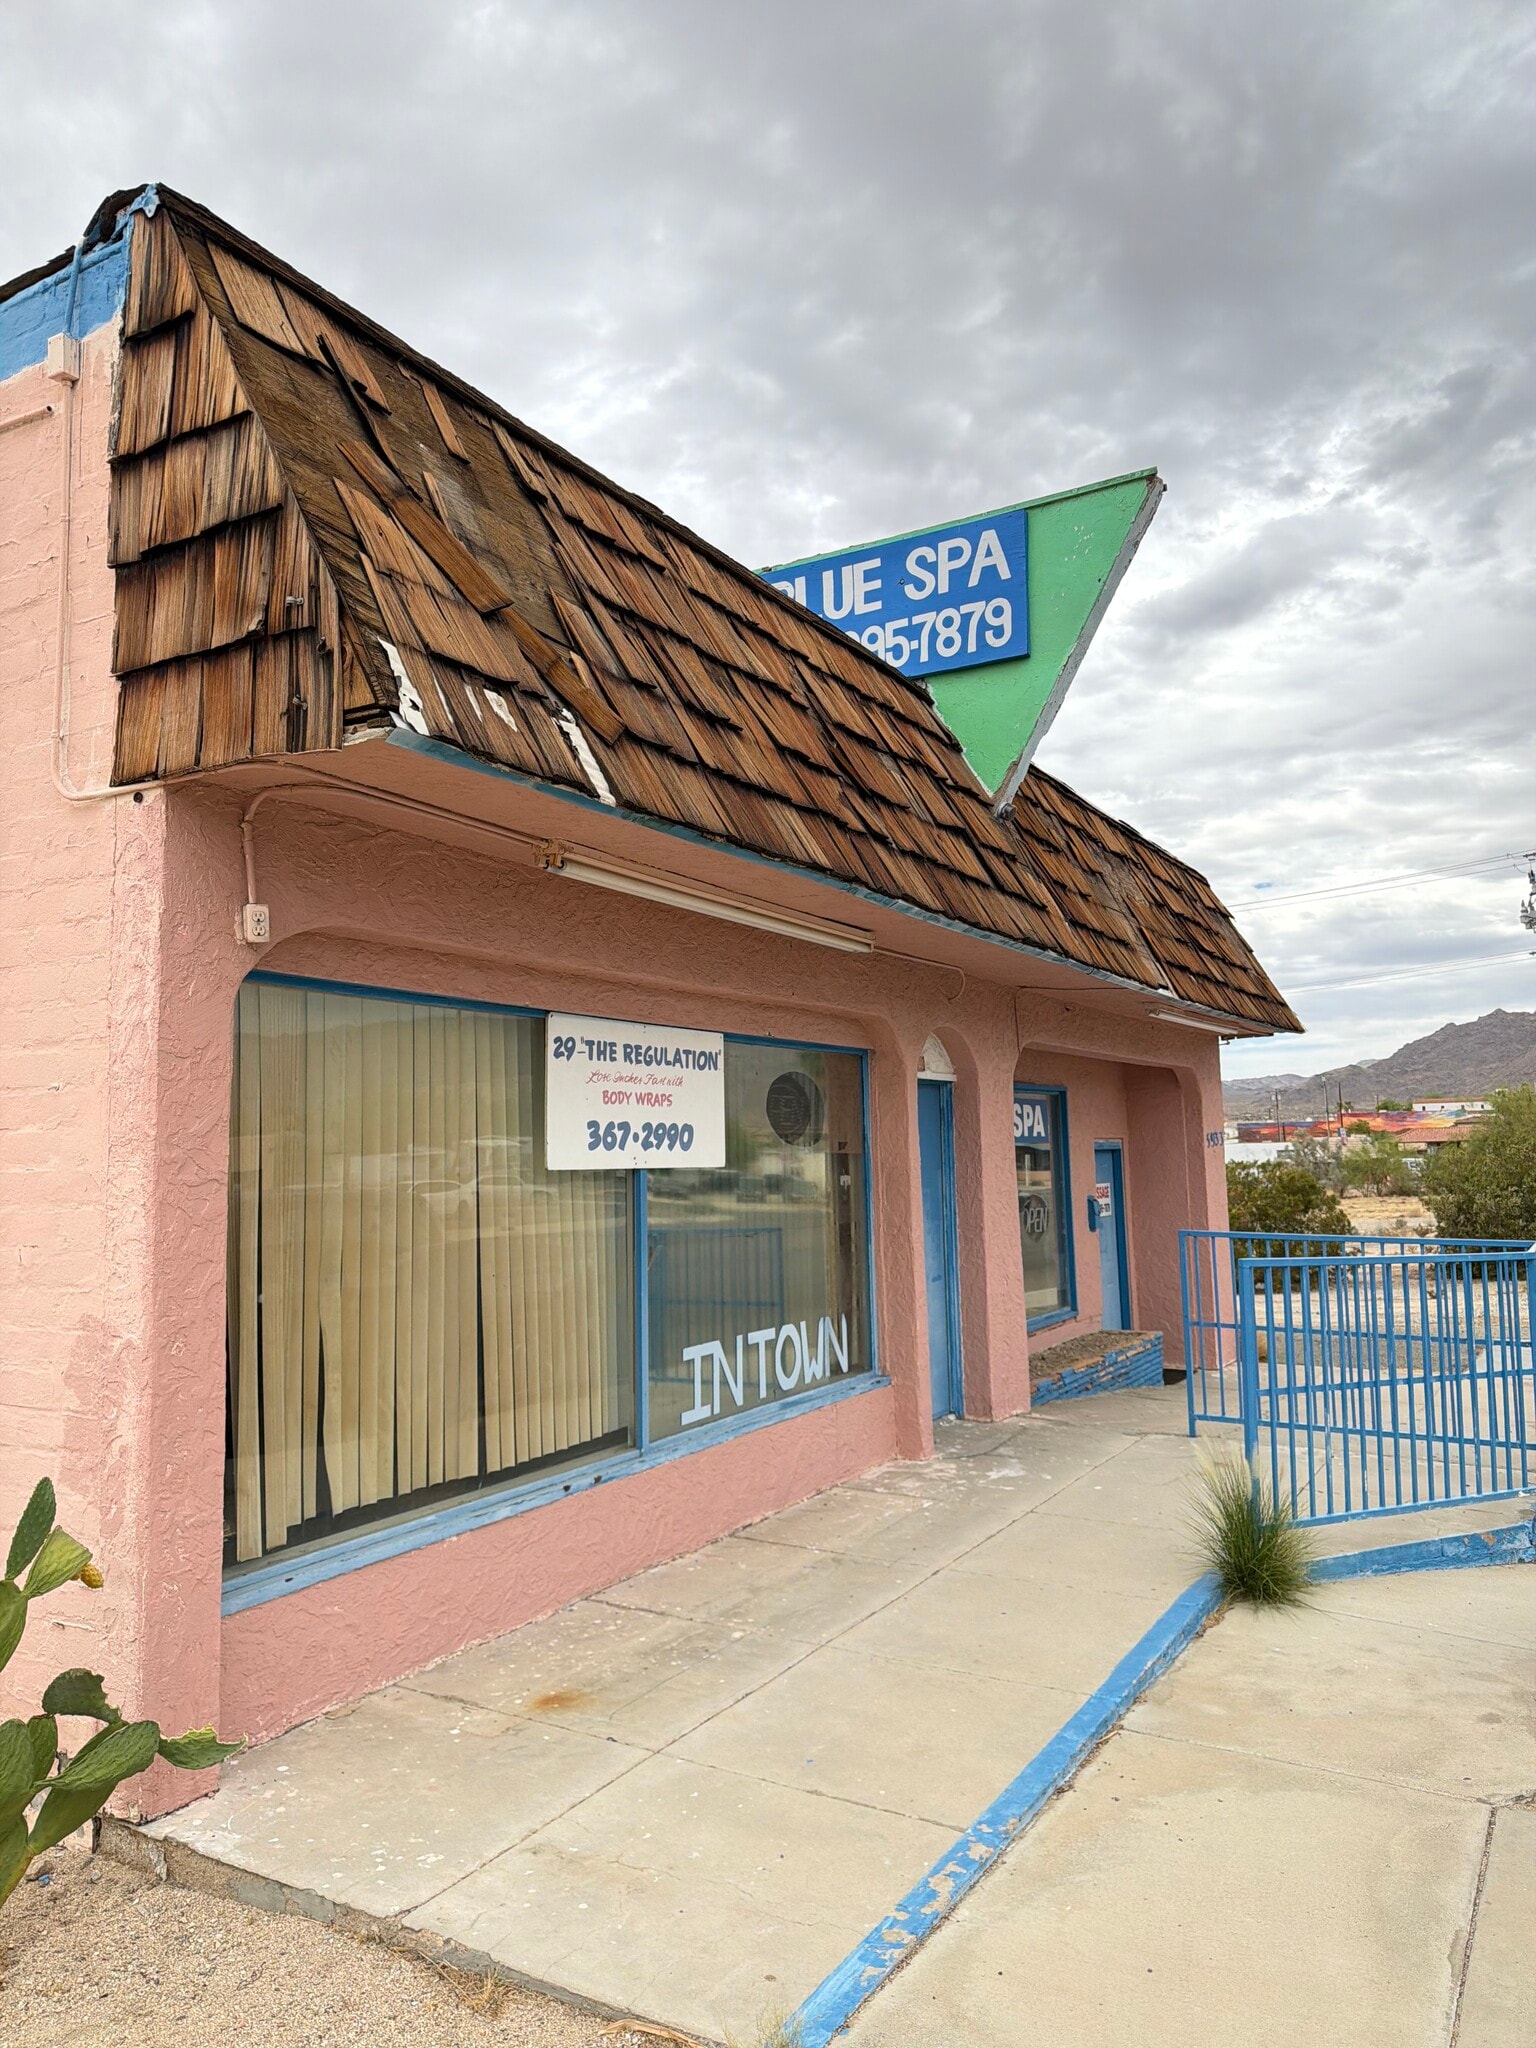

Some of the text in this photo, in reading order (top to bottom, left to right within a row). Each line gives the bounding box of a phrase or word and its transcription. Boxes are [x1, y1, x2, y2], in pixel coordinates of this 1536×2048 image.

[904, 529, 1012, 601] SPA
[602, 1089, 673, 1107] BODY WRAPS
[1013, 1103, 1046, 1138] SPA
